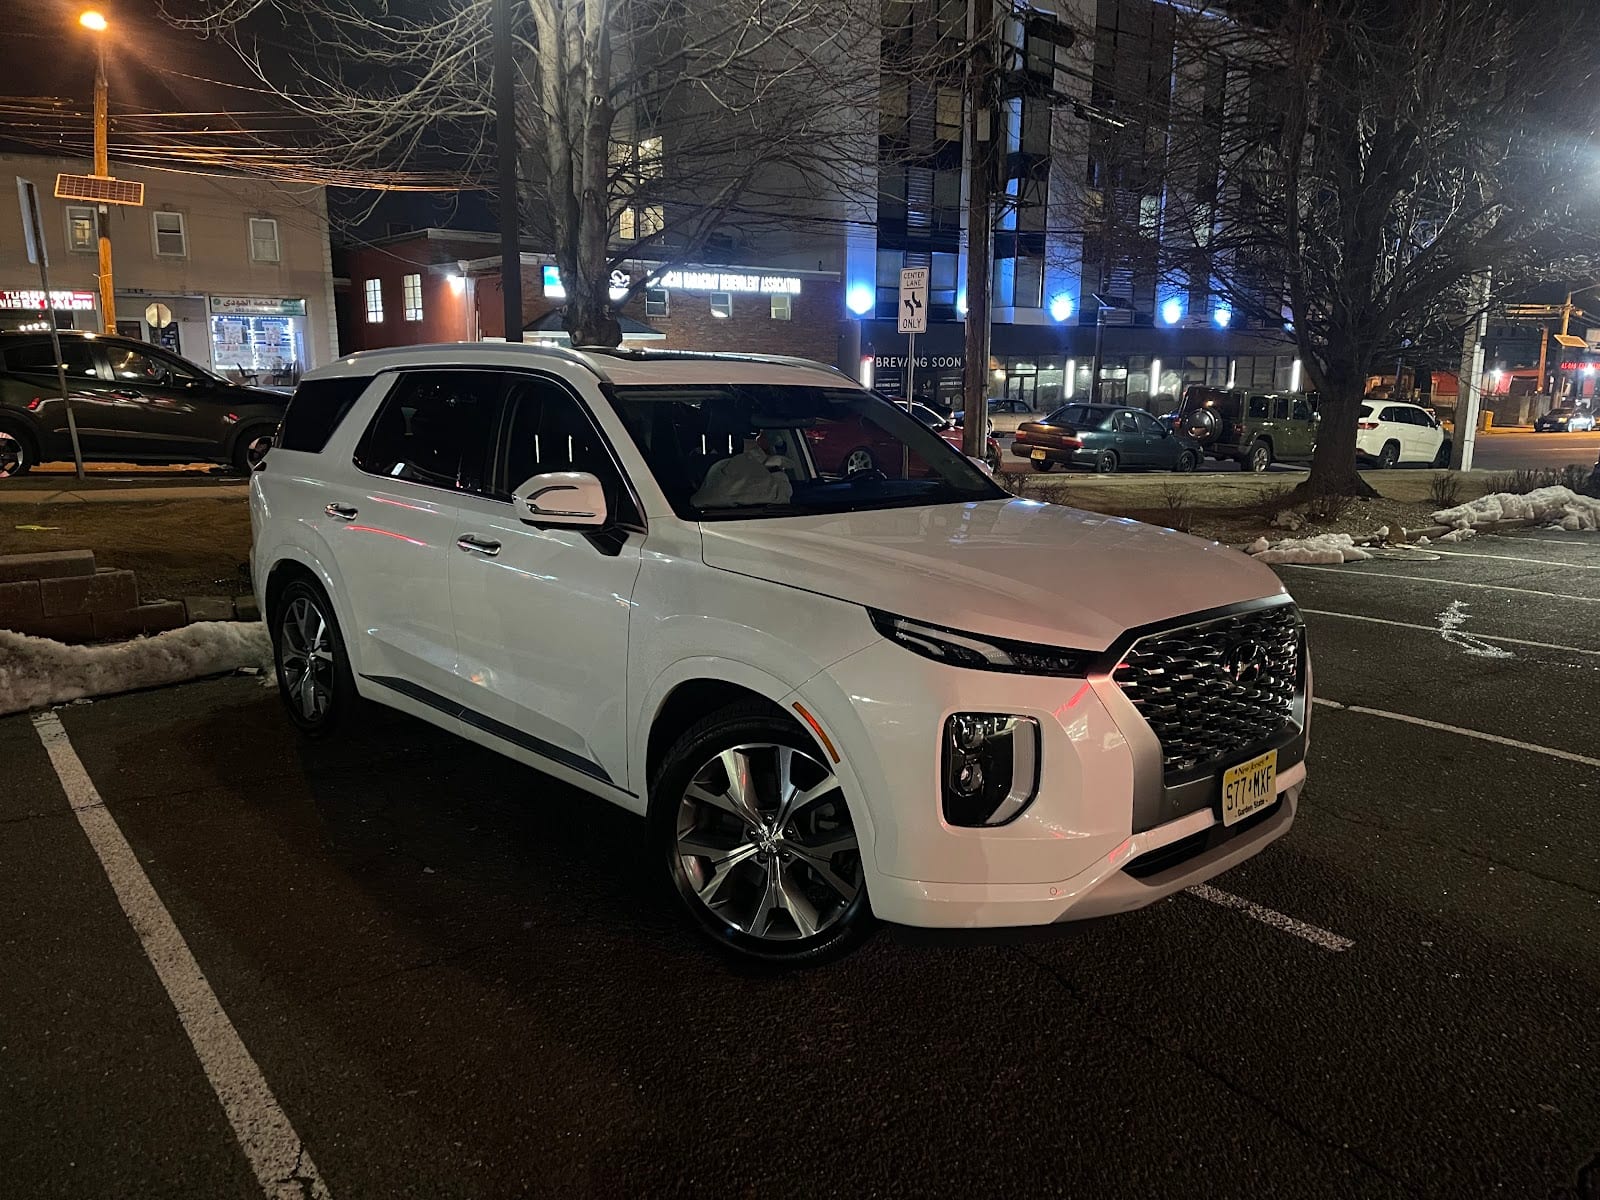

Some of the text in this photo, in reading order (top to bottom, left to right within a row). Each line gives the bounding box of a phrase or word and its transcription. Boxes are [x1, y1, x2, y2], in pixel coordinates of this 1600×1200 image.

[903, 318, 921, 328] ONLY
[876, 357, 961, 367] BREWNG SOON
[1238, 799, 1265, 816] Garden State
